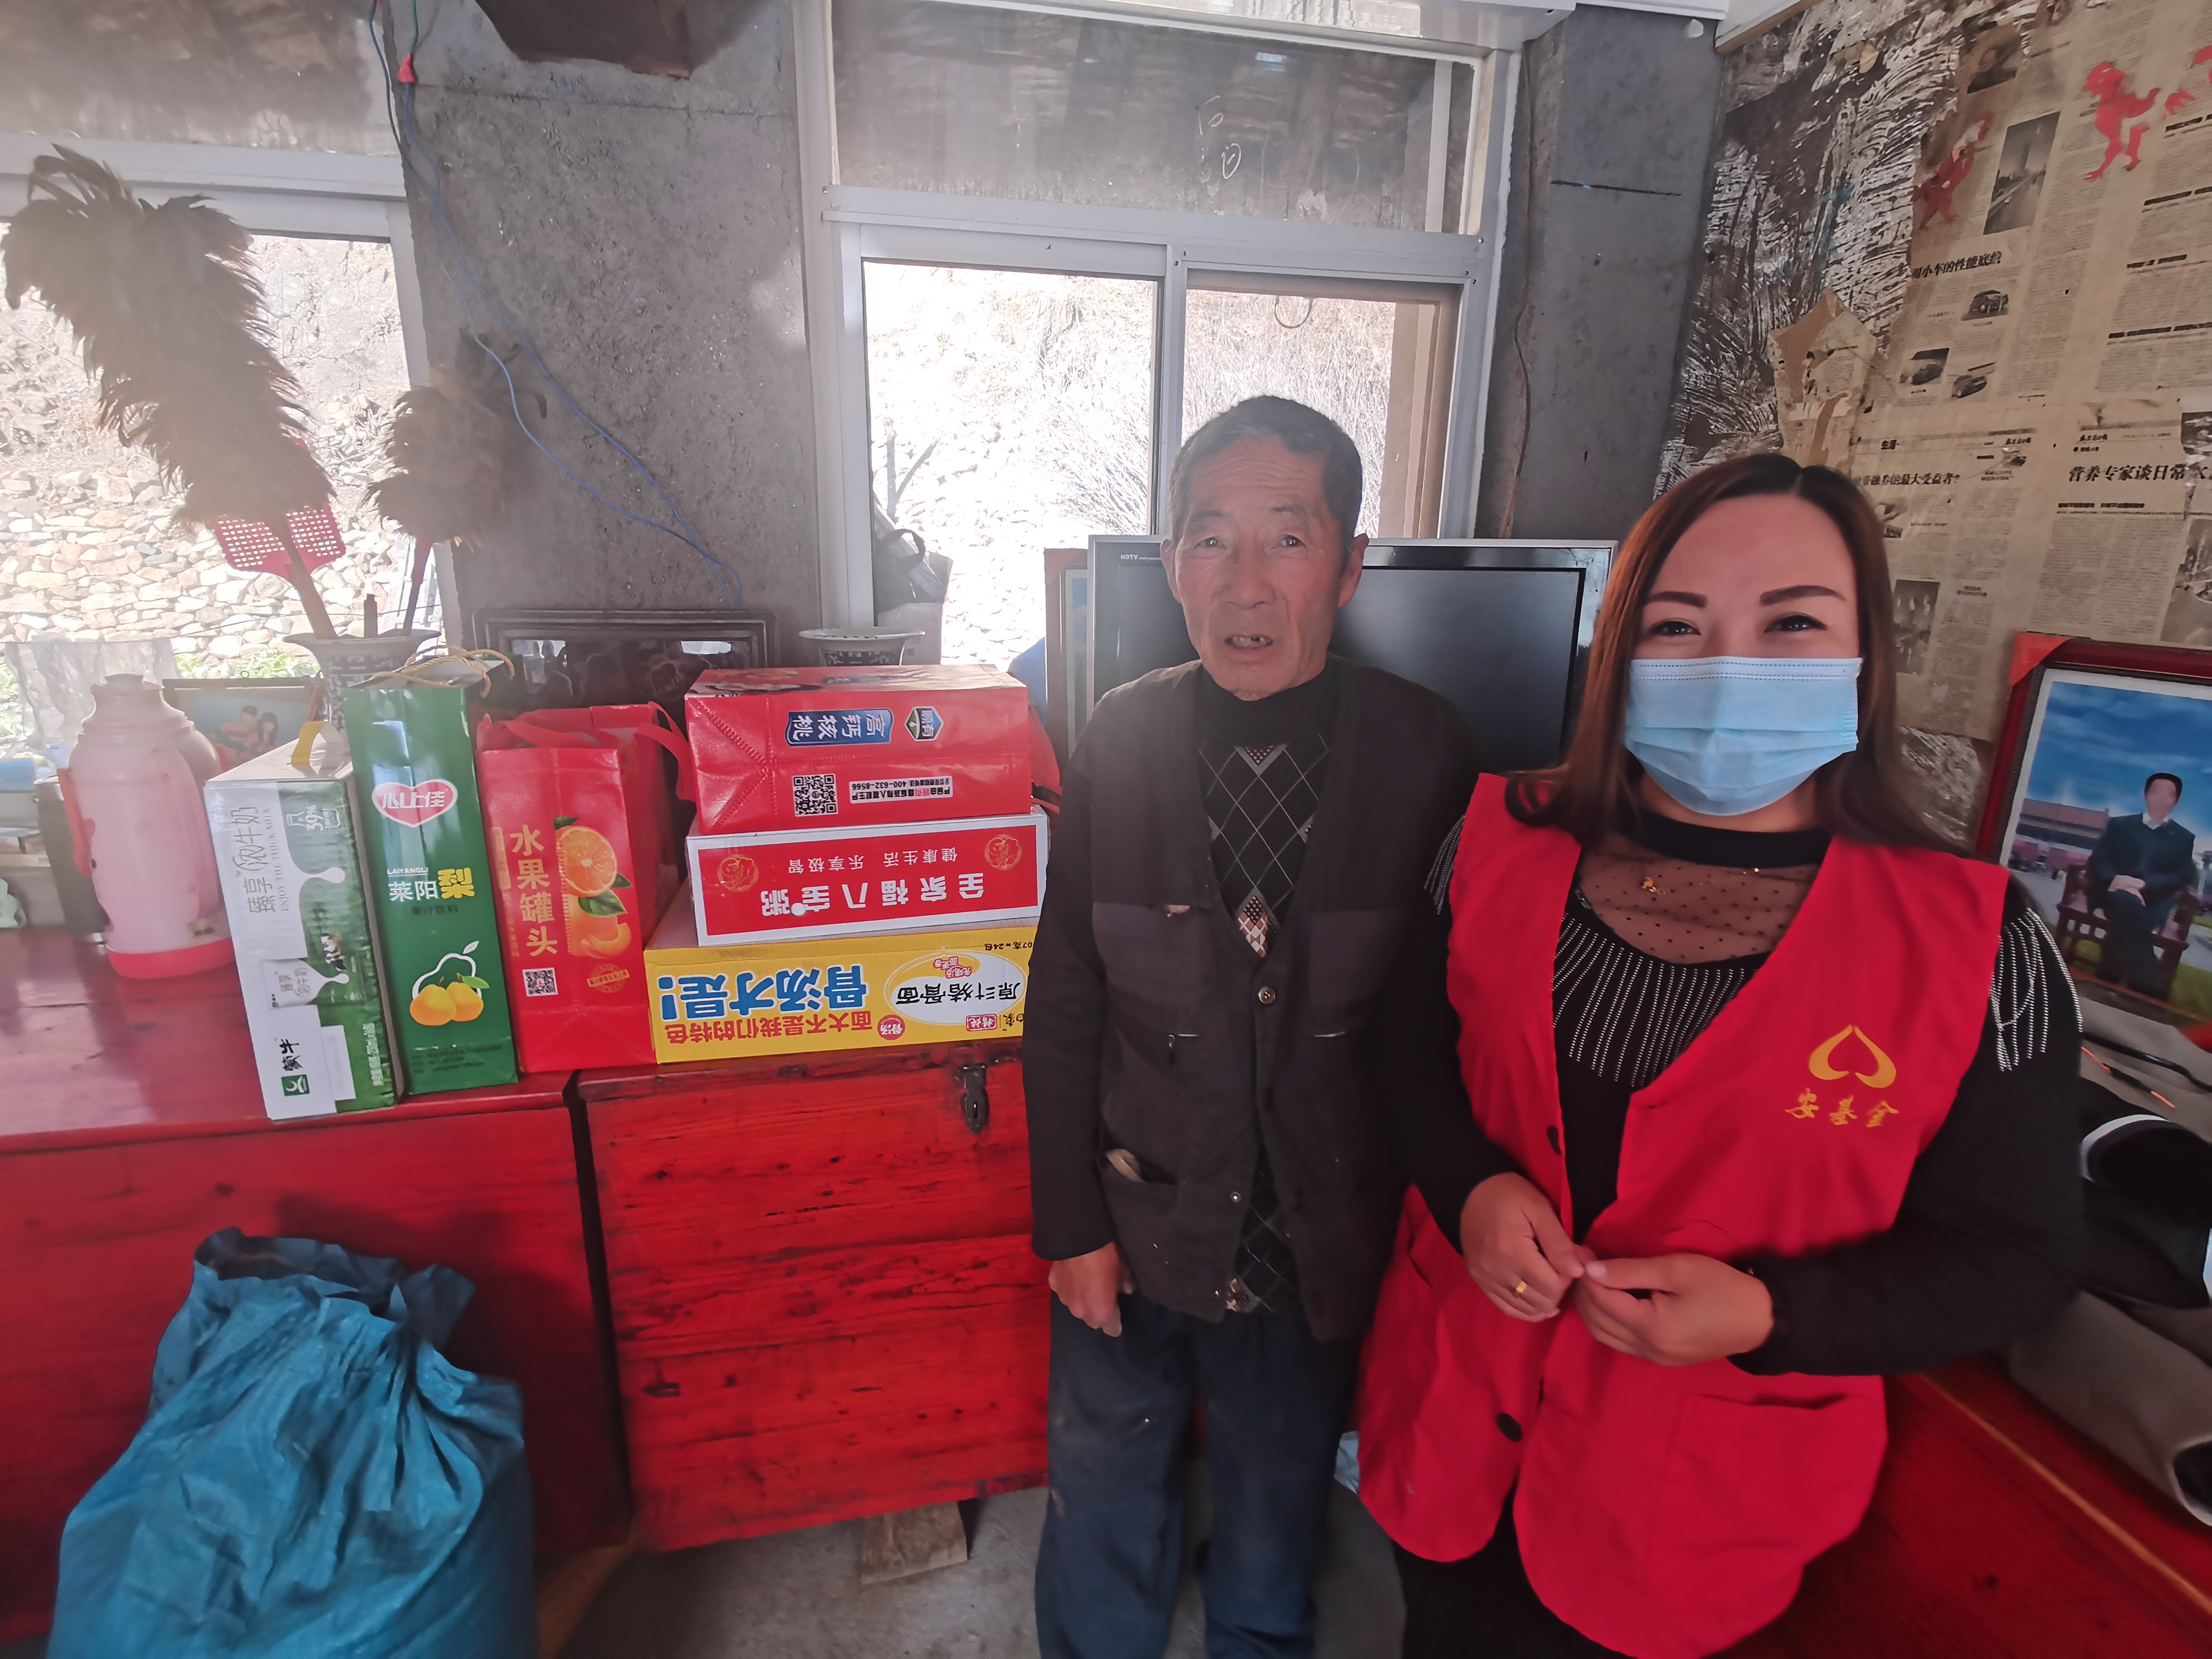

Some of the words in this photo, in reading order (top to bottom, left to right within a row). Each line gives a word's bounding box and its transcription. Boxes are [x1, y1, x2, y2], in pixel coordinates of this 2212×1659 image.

[792, 713, 886, 742] 高钙核桃
[852, 781, 907, 791] 400-632-8566
[382, 791, 445, 809] 心上佳
[262, 807, 274, 830] MILK
[267, 832, 280, 861] THICK
[883, 847, 958, 867] 健康生活
[274, 864, 283, 881] THE
[788, 854, 865, 874] 乐享极智
[388, 867, 475, 902] 莱阳梨
[510, 825, 558, 957] 水果罐头
[760, 872, 985, 917] 全家福八宝粥
[278, 885, 289, 912] ENJOY
[946, 965, 972, 978] 先喝汤
[658, 964, 869, 1022] 骨汤才是!
[895, 982, 1021, 1005] 原汁猪骨面
[664, 1010, 873, 1045] 面大不是我们的特色
[880, 1023, 903, 1035] 骨汤
[1003, 1012, 1024, 1027] 白象
[278, 1038, 302, 1071] 蒙牛
